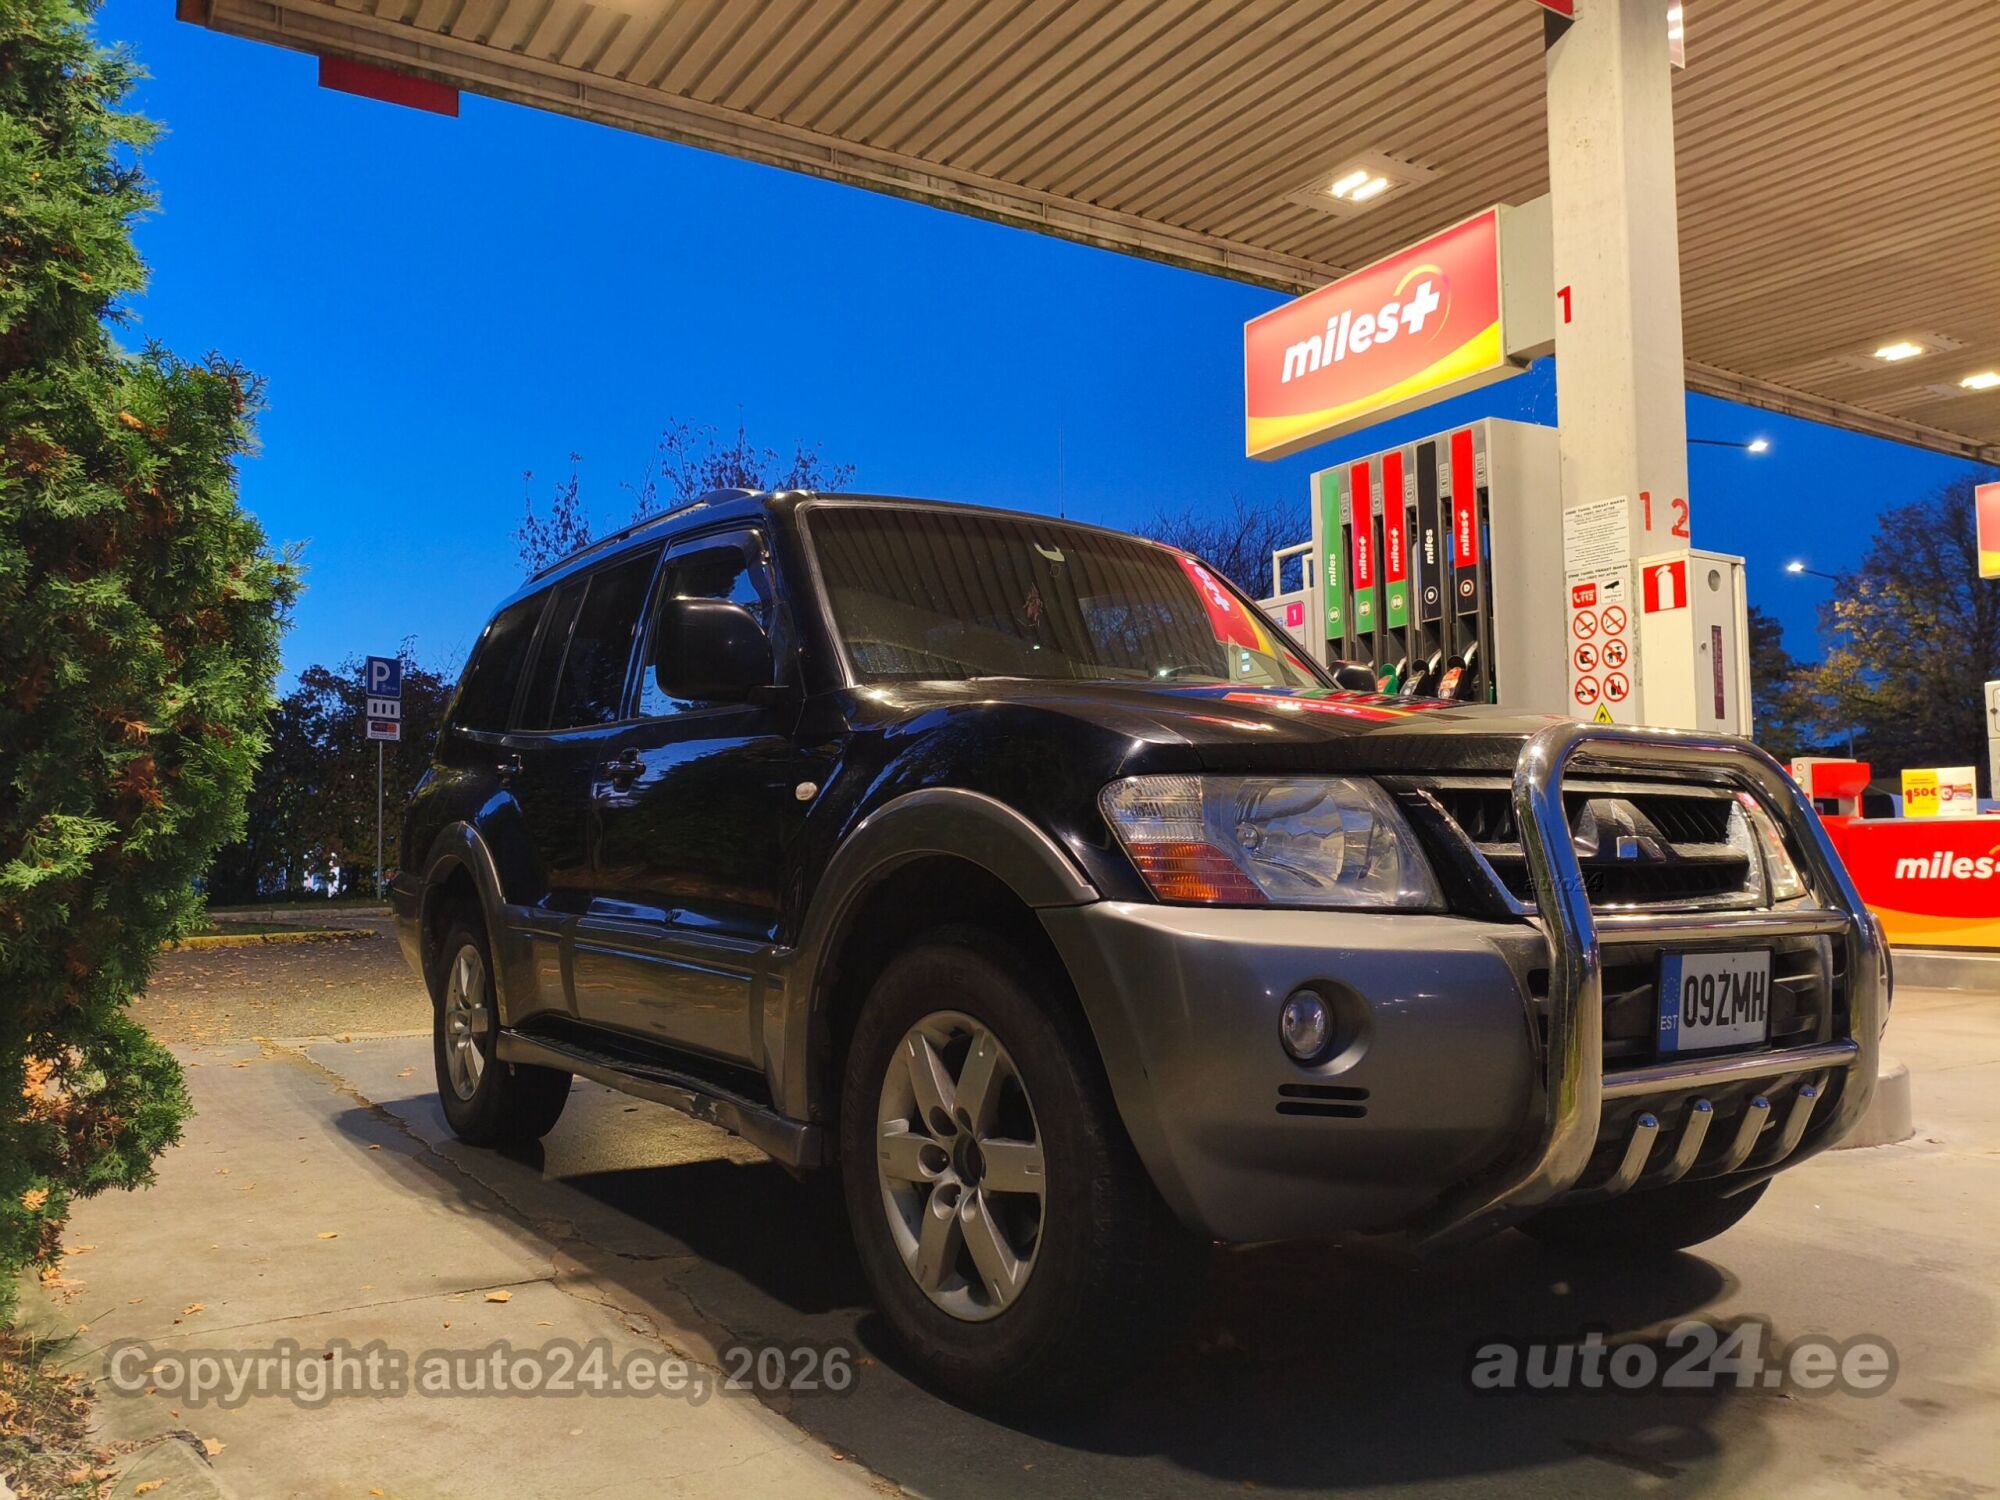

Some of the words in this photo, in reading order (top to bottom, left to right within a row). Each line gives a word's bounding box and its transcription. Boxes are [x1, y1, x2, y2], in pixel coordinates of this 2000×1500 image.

[1557, 285, 1572, 324] 1
[1281, 280, 1440, 384] miles+
[1639, 491, 1651, 531] 1
[1671, 498, 1689, 538] 2
[1424, 528, 1434, 565] miles
[1328, 553, 1337, 587] miles
[1292, 609, 1298, 621] 1
[372, 661, 391, 691] P
[1683, 971, 1766, 1028] 09ZMH
[1660, 1014, 1678, 1031] EST
